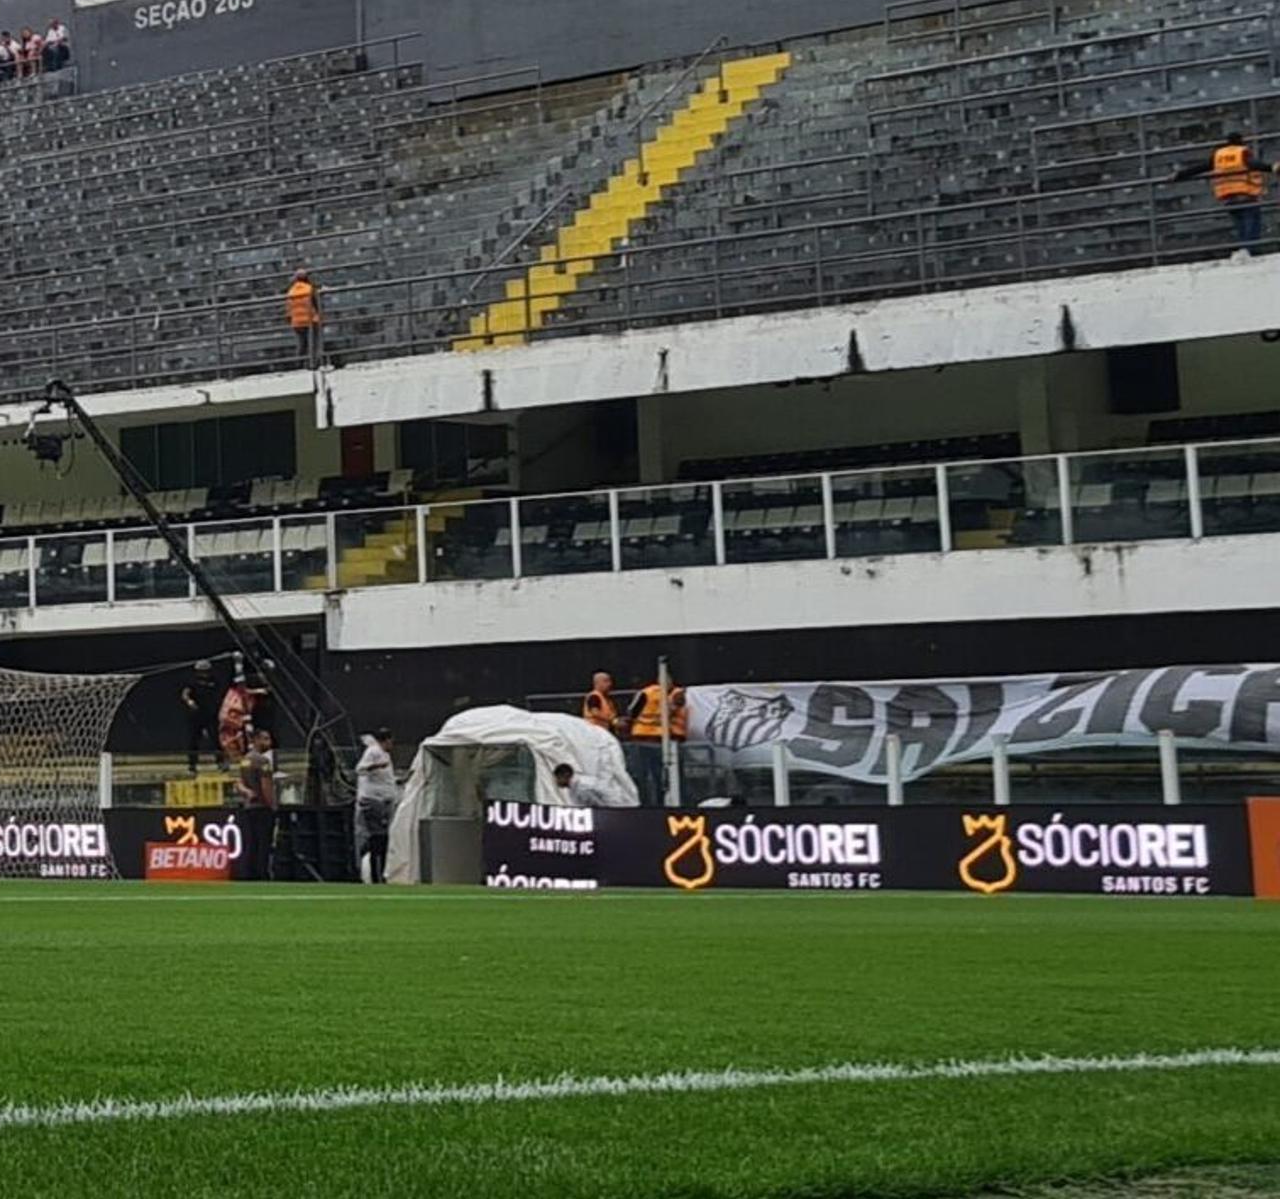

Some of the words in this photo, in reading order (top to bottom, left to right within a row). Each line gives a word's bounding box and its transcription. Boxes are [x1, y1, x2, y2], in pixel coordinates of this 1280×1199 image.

[530, 837, 577, 854] SANTOS
[715, 814, 879, 864] SÓCIOREI
[1016, 813, 1209, 867] SÓCIOREI
[149, 847, 228, 869] BETANO
[788, 872, 854, 887] SANTOS
[858, 873, 881, 887] FC
[1102, 875, 1177, 893] SANTOS
[1182, 876, 1210, 893] FC
